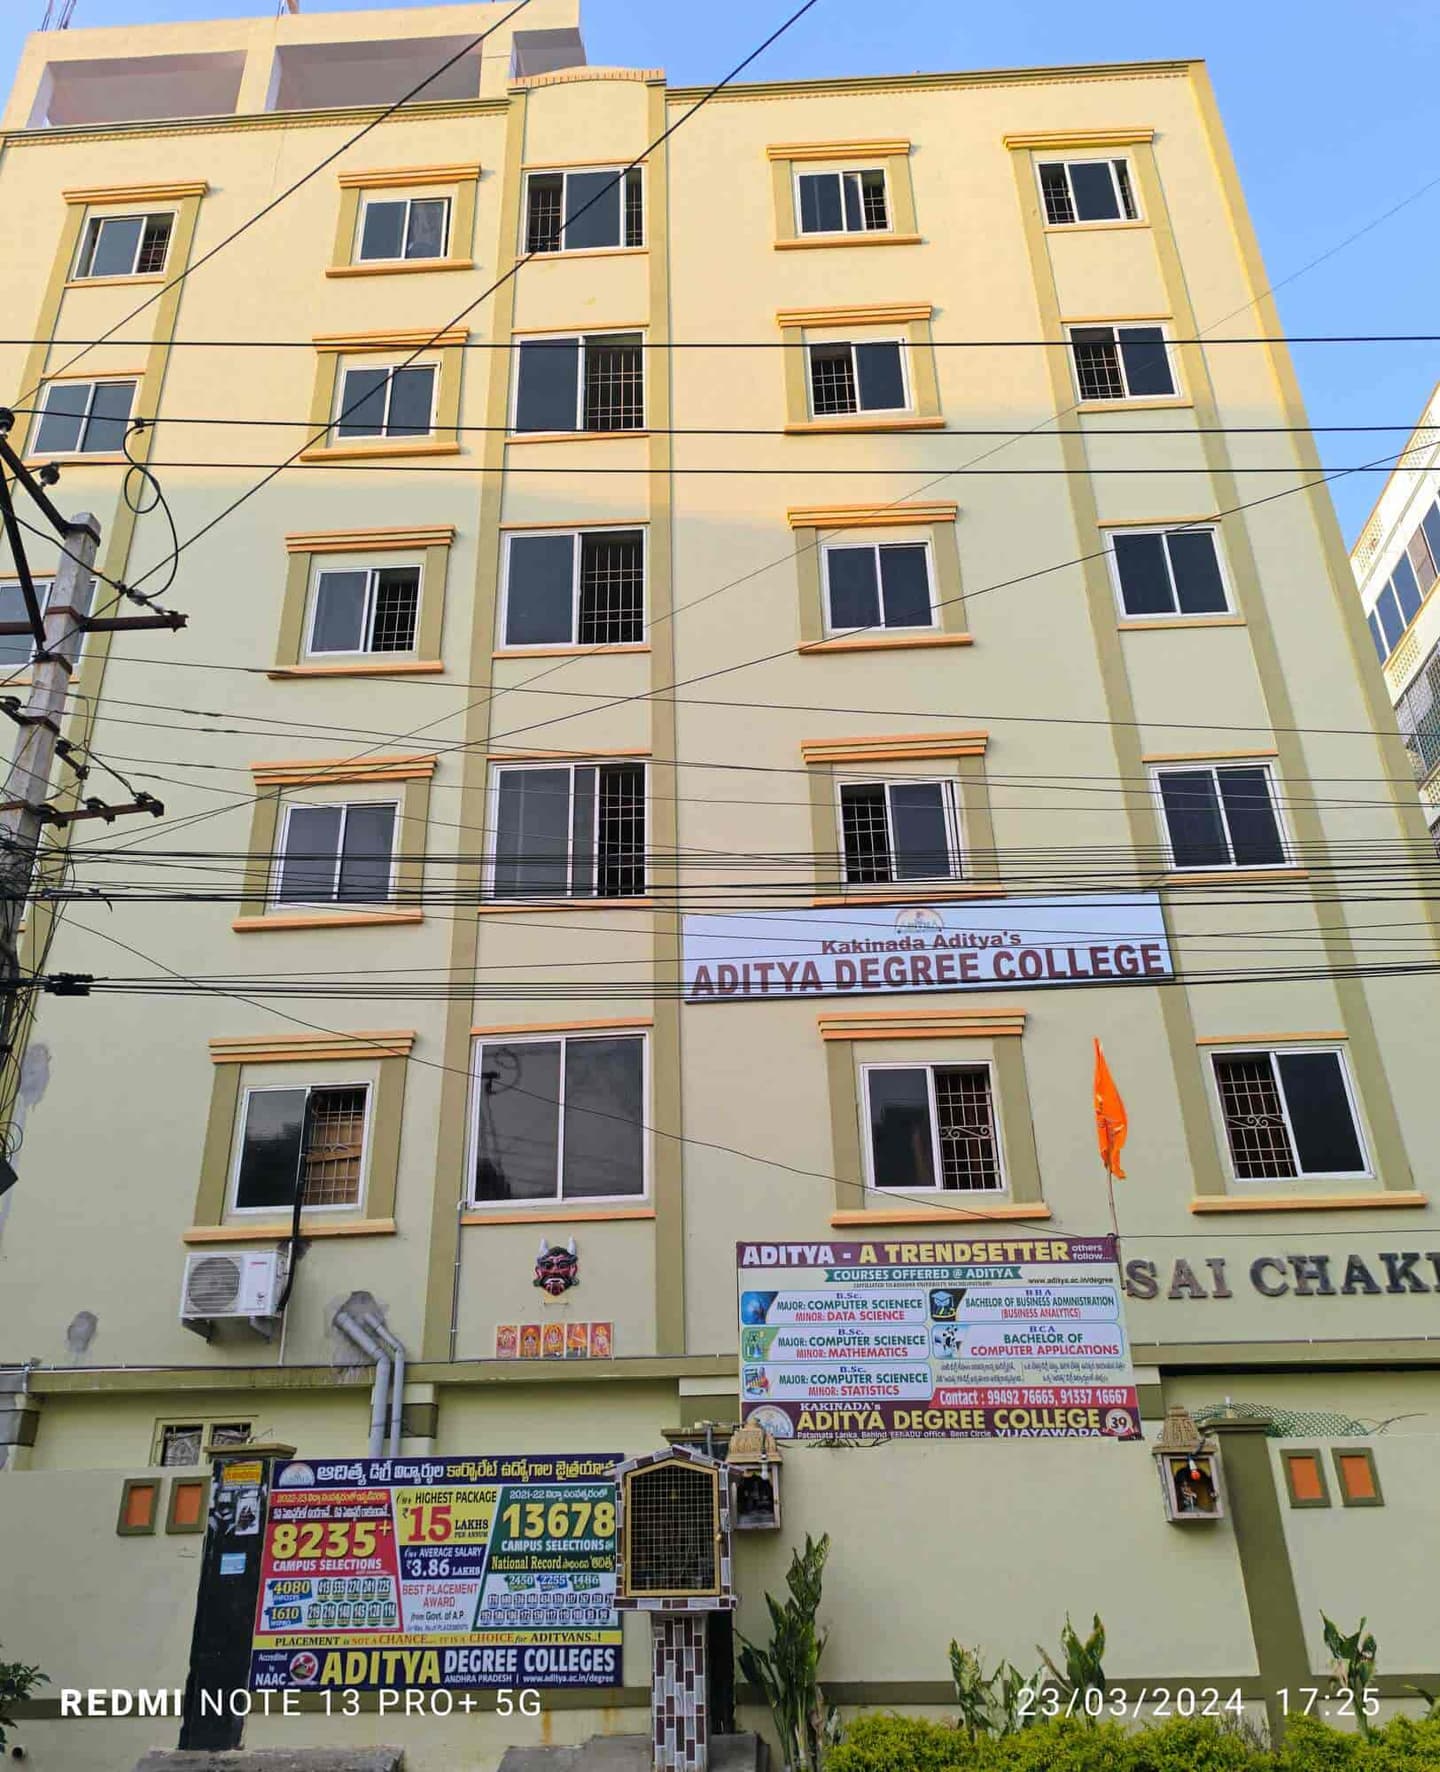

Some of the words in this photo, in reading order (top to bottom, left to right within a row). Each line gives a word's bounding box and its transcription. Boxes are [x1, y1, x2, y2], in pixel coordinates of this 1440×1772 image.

[821, 935, 925, 954] Kakinada
[934, 930, 1022, 949] Aditya's
[691, 958, 823, 996] ADITYA
[834, 951, 982, 990] DEGREE
[992, 943, 1165, 981] COLLEGE
[742, 1245, 835, 1265] ADITYA
[859, 1244, 878, 1264] A
[885, 1241, 1070, 1264] TRENDSETTER
[1071, 1244, 1103, 1253] others
[833, 1270, 889, 1281] COURSES
[892, 1269, 949, 1280] OFFERED
[953, 1268, 963, 1279] @
[965, 1267, 1014, 1279] ADITYA
[1126, 1257, 1233, 1300] SAI
[1027, 1277, 1114, 1286] www.aditya.ac.in/degree
[777, 1301, 806, 1311] MAJOR:
[807, 1299, 868, 1310] COMPUTER
[872, 1298, 923, 1309] SCIENECE
[965, 1298, 1002, 1308] BACHELOR
[1004, 1298, 1016, 1307] OF
[1016, 1297, 1051, 1307] BUSINESS
[1052, 1296, 1115, 1306] ADMINISTRATION
[795, 1312, 826, 1322] MINOR:
[827, 1311, 856, 1321] DATA
[859, 1311, 905, 1321] SCIENCE
[1001, 1309, 1038, 1320] (BUSINESS
[1040, 1308, 1081, 1319] ANALYTICS)
[838, 1328, 864, 1336] B.Sc.
[778, 1338, 808, 1348] MAJOR:
[809, 1336, 870, 1346] COMPUTER
[873, 1335, 926, 1346] SCIENECE
[1003, 1333, 1064, 1345] BACHELOR
[1067, 1333, 1084, 1344] OF
[796, 1350, 827, 1359] MINOR:
[828, 1347, 908, 1358] MATHEMATICS
[970, 1346, 1033, 1356] COMPUTER
[1036, 1344, 1120, 1356] APPLICATIONS
[779, 1374, 809, 1385] MAJOR:
[810, 1374, 872, 1384] COMPUTER
[876, 1373, 929, 1384] SCIENECE
[808, 1387, 839, 1396] MINOR:
[840, 1385, 900, 1396] STATISTICS
[939, 1391, 979, 1406] Contact
[986, 1389, 1020, 1405] 99492
[1060, 1389, 1093, 1404] 91337
[1095, 1388, 1128, 1405] 16667
[800, 1402, 881, 1411] KAKINADA's
[796, 1411, 886, 1431] ADITYA
[893, 1410, 986, 1430] DEGREE
[993, 1408, 1101, 1429] COLLEGE
[1110, 1415, 1128, 1429] 39
[995, 1428, 1101, 1438] VIJAYAWADA
[316, 1463, 366, 1486] ఆదిత్య
[415, 1491, 454, 1504] HIGHEST
[455, 1491, 497, 1503] PACKAGE
[510, 1489, 544, 1500] 2021-22
[455, 1519, 489, 1530] LAKHS
[502, 1502, 616, 1538] 13678
[501, 1540, 542, 1551] CAMPUS
[545, 1539, 604, 1551] SELECTIONS
[419, 1547, 454, 1558] AVERAGE
[454, 1547, 482, 1557] SALARY
[272, 1559, 317, 1572] CAMPUS
[320, 1558, 382, 1571] SELECTIONS
[491, 1556, 529, 1570] National
[531, 1555, 562, 1570] Record
[452, 1566, 481, 1576] LAKHS
[541, 1575, 567, 1585] 2255
[273, 1581, 311, 1595] 4080
[402, 1585, 425, 1595] BEST
[427, 1583, 478, 1594] PLACEMENT
[423, 1597, 456, 1608] AWARD
[271, 1607, 299, 1620] 1610
[275, 1636, 341, 1647] PLACEMENT
[468, 1633, 513, 1644] CHOICE
[514, 1636, 528, 1645] for
[320, 1650, 441, 1685] ADITYA
[444, 1650, 517, 1673] DEGREE
[523, 1648, 615, 1673] COLLEGES
[255, 1672, 288, 1686] NAAC
[444, 1674, 477, 1684] ANDHRA
[478, 1673, 513, 1683] PRADESH
[523, 1673, 614, 1685] www.aditya.ac.in/degree
